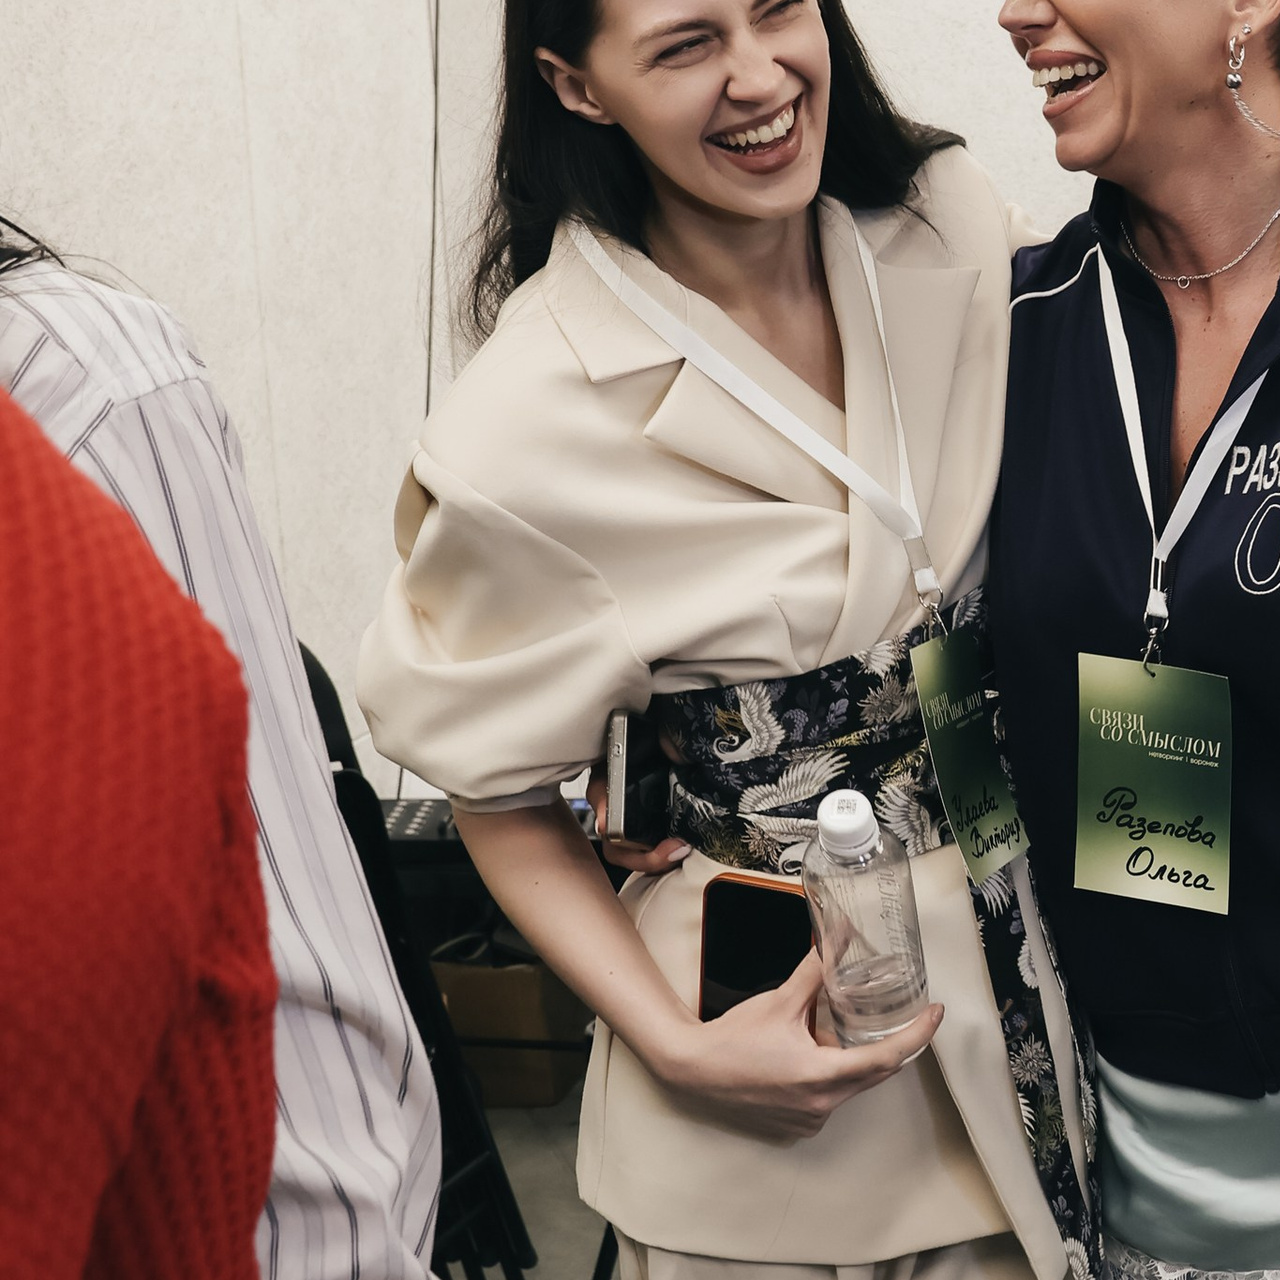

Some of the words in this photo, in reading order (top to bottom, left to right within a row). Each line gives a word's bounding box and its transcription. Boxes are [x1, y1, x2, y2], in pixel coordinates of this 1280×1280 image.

[1089, 706, 1145, 731] СВЯЗИ
[1100, 723, 1123, 742] СО
[1127, 728, 1221, 758] СМЫСЛОМ
[1096, 786, 1216, 849] Разепова
[1126, 846, 1215, 891] Ольга
